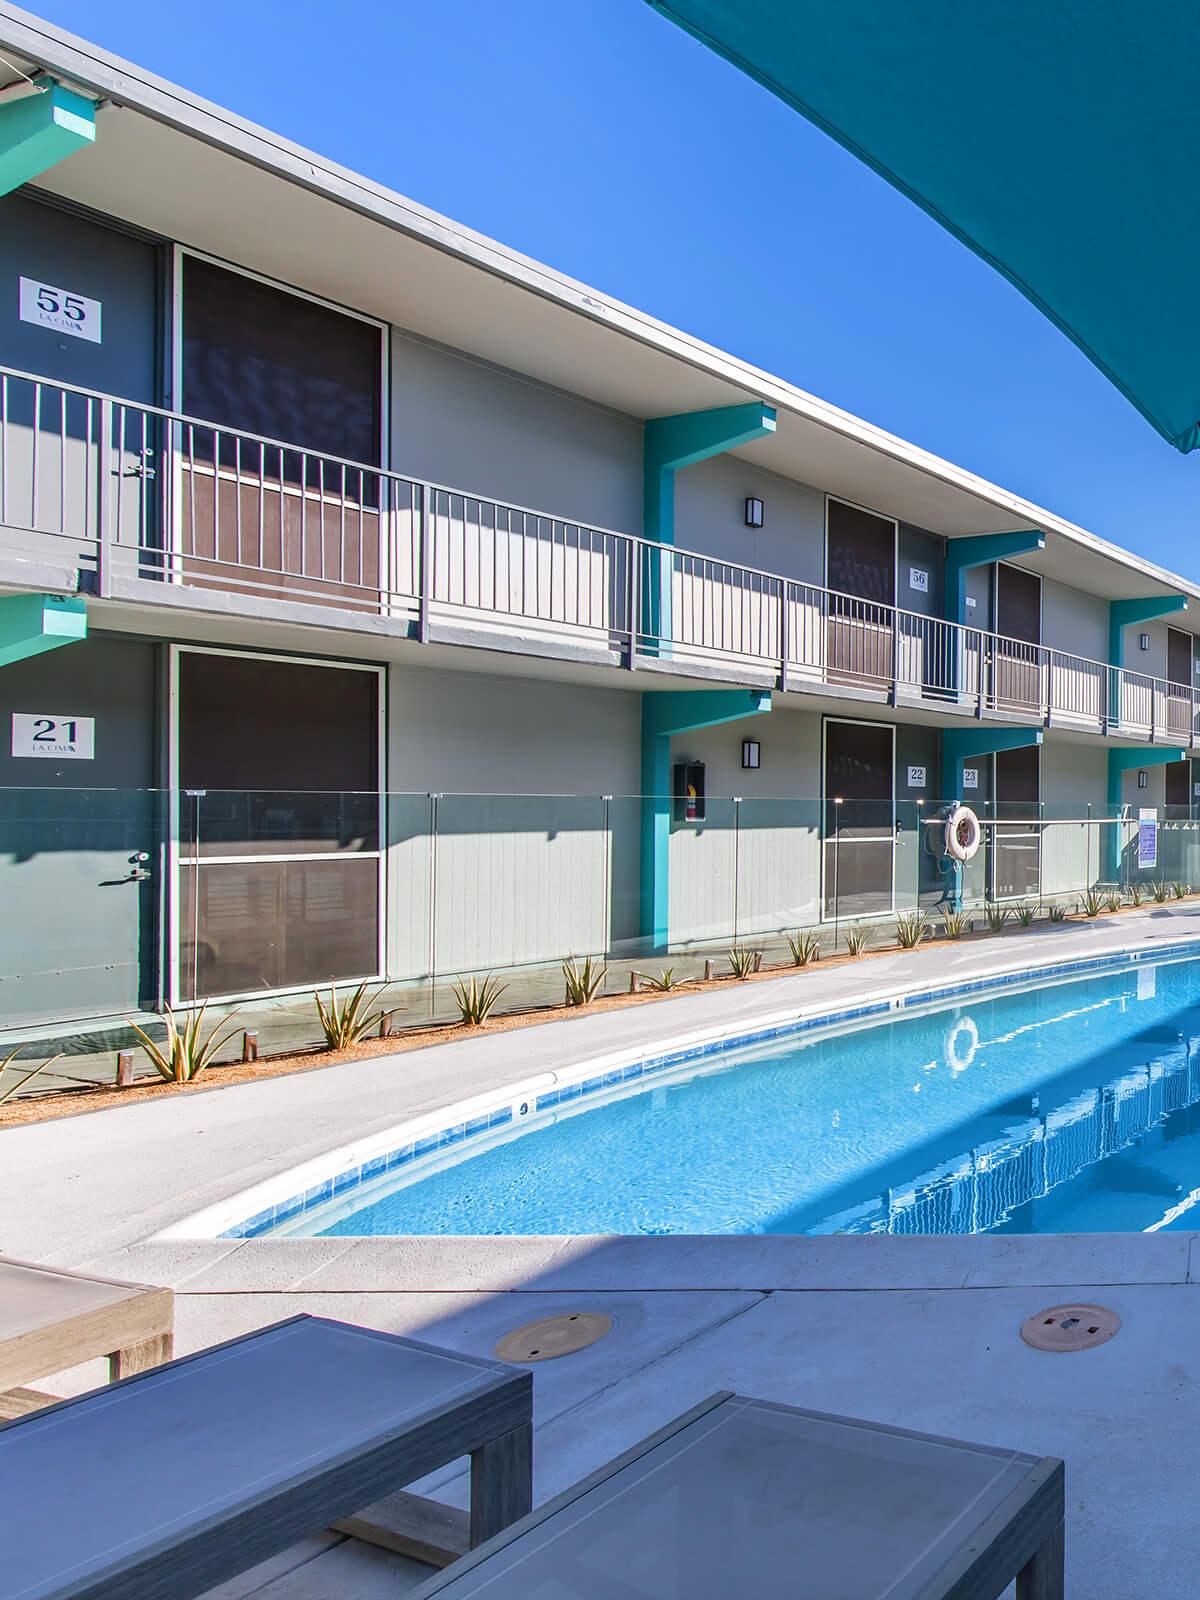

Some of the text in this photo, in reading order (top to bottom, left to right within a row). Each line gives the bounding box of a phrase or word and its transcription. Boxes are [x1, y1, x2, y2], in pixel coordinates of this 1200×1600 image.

[36, 287, 86, 321] 55
[913, 570, 925, 585] 56
[32, 719, 77, 743] 21
[32, 743, 77, 753] LA CIMA
[911, 768, 923, 780] 22
[964, 770, 976, 781] 23
